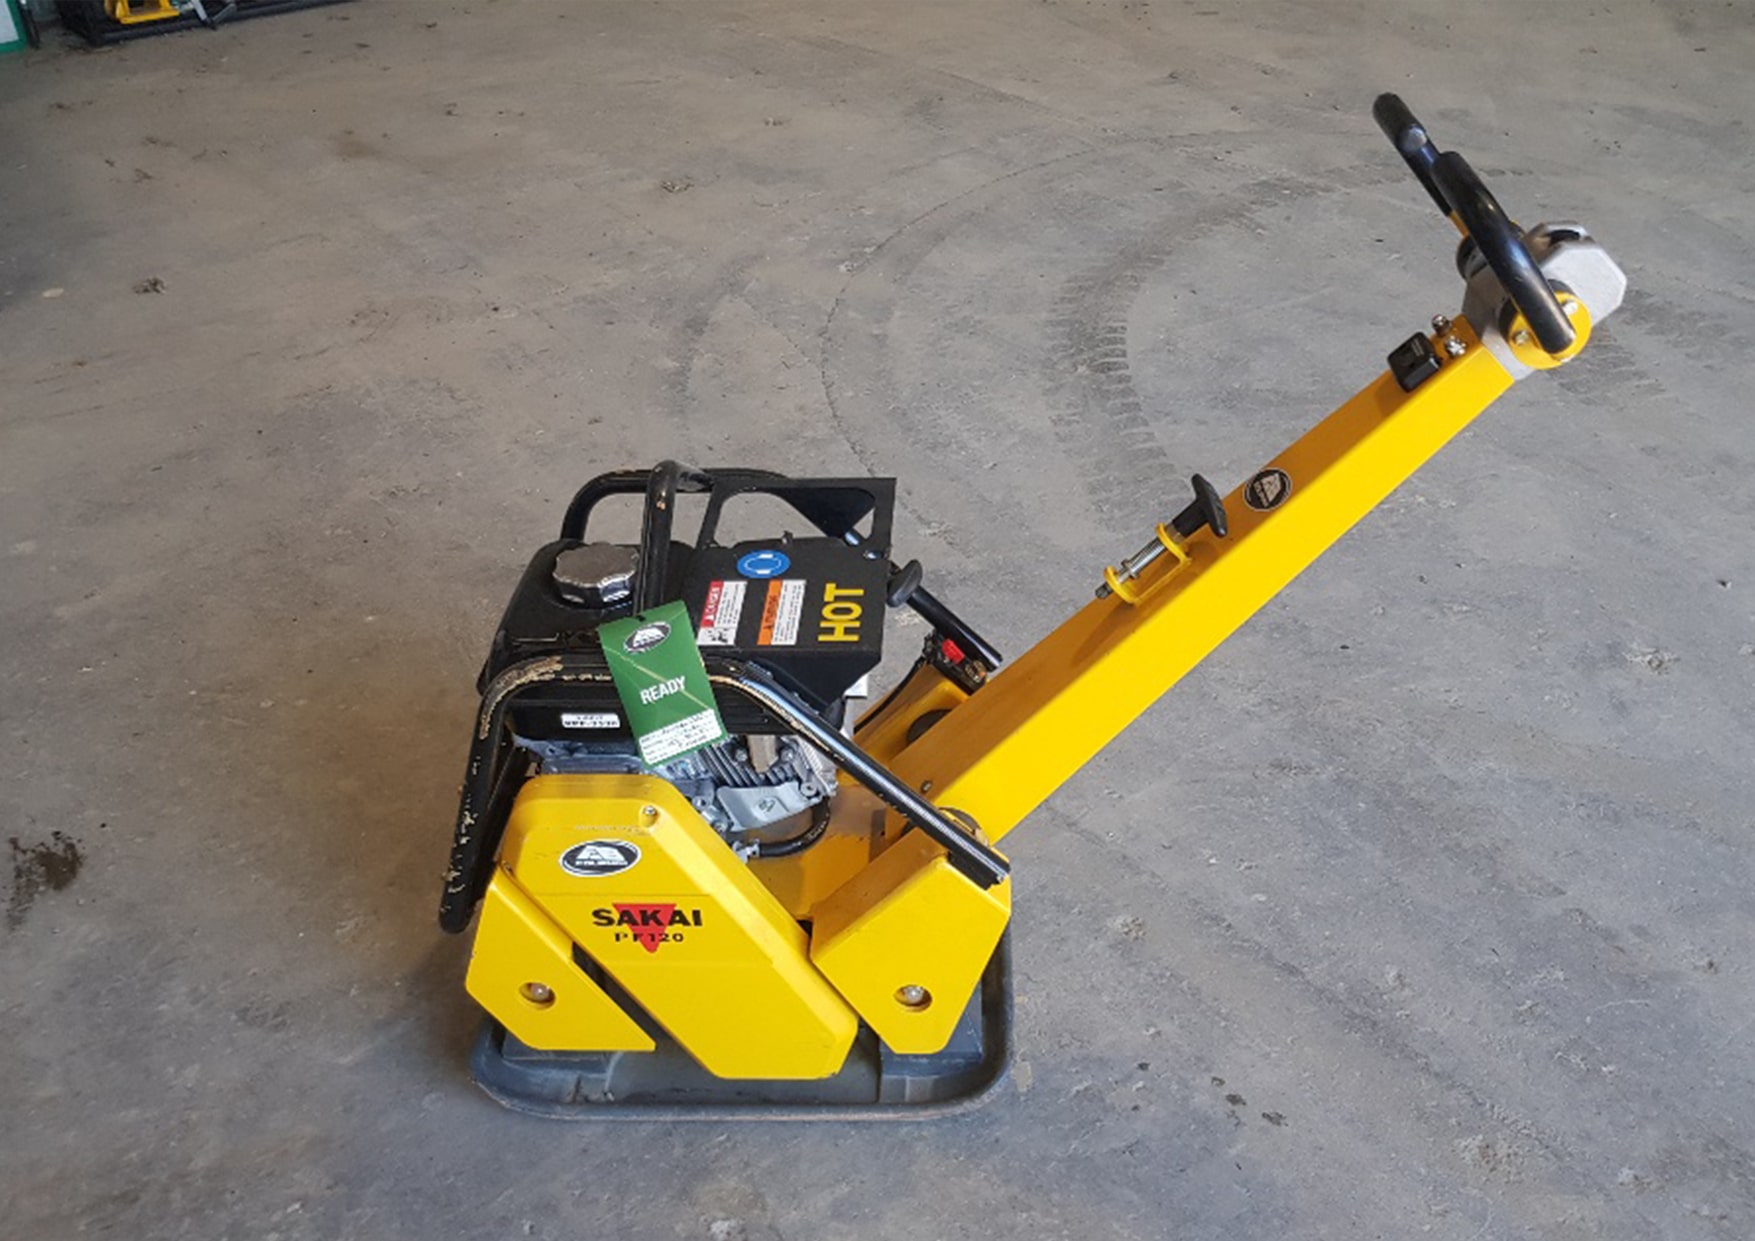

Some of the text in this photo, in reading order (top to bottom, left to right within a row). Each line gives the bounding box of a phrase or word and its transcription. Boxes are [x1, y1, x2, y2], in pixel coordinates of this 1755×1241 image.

[817, 582, 865, 642] HOT
[640, 675, 686, 705] READY
[591, 908, 703, 927] SAKAI
[614, 932, 685, 942] PF120
